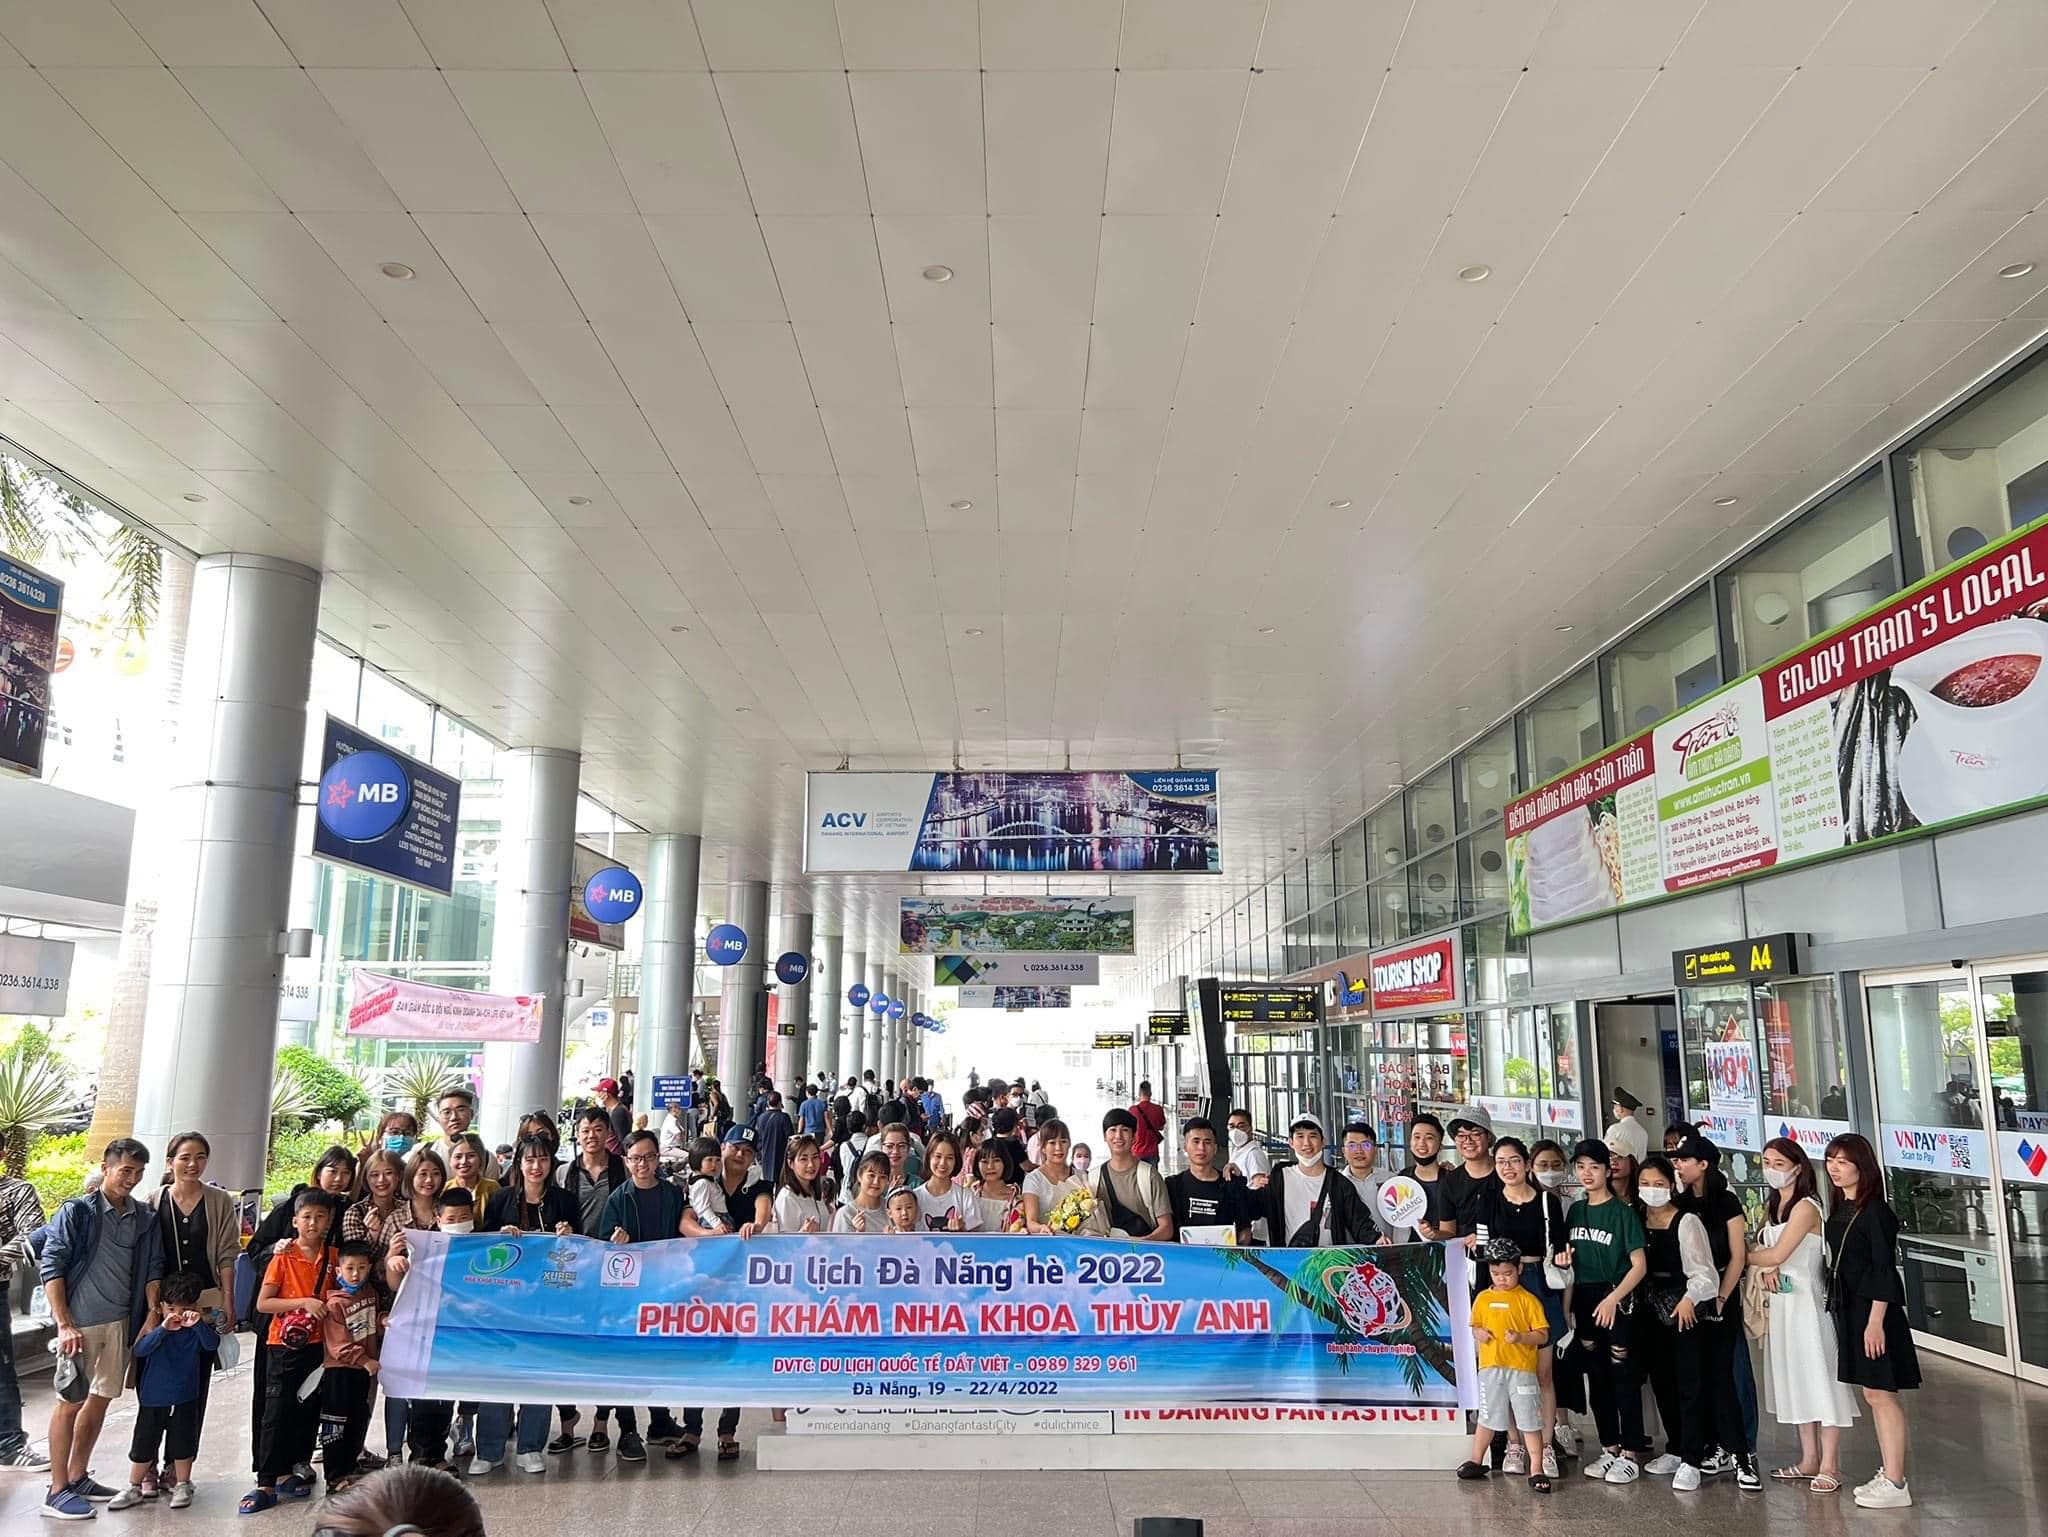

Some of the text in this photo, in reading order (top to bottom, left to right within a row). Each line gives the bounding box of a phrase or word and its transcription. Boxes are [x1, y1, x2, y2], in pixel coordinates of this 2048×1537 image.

[1777, 547, 2046, 703] ENJOY TRAN'S LOCAL
[1152, 784, 1173, 792] 0236
[1174, 784, 1193, 792] 3614
[1525, 797, 1537, 825] ĐÀ
[1573, 773, 1593, 800] ĐẶC
[1594, 759, 1615, 791] SẢN
[1615, 742, 1645, 782] TRẦN
[358, 784, 399, 803] MB
[1791, 793, 1808, 806] 100%
[821, 812, 868, 828] ACV
[1822, 817, 1827, 827] 5
[1830, 816, 1838, 827] kg
[608, 889, 635, 903] MB
[724, 940, 743, 951] MB
[1750, 943, 1772, 972] A4
[789, 965, 804, 974] MB
[1374, 959, 1412, 993] TOURISM
[1413, 951, 1442, 986] SHOP
[1894, 1130, 1948, 1151] VNPAY QR
[1901, 1150, 1935, 1165] Scan to Pay
[749, 1255, 1162, 1292] Du lịch Đà Nẵng hè 2022
[637, 1296, 1268, 1335] PHÒNG KHÁM NHA KHOA THÙY ANH
[1345, 1343, 1363, 1353] hành
[1363, 1344, 1389, 1354] chuyên
[1390, 1344, 1415, 1355] nghiệp
[774, 1353, 1137, 1375] DVTC: DU LỊCH QUỐC TẾ ĐẤT VIỆT 0989 329 961
[853, 1381, 1058, 1399] Đà Nẵng, 19 22/4/2022
